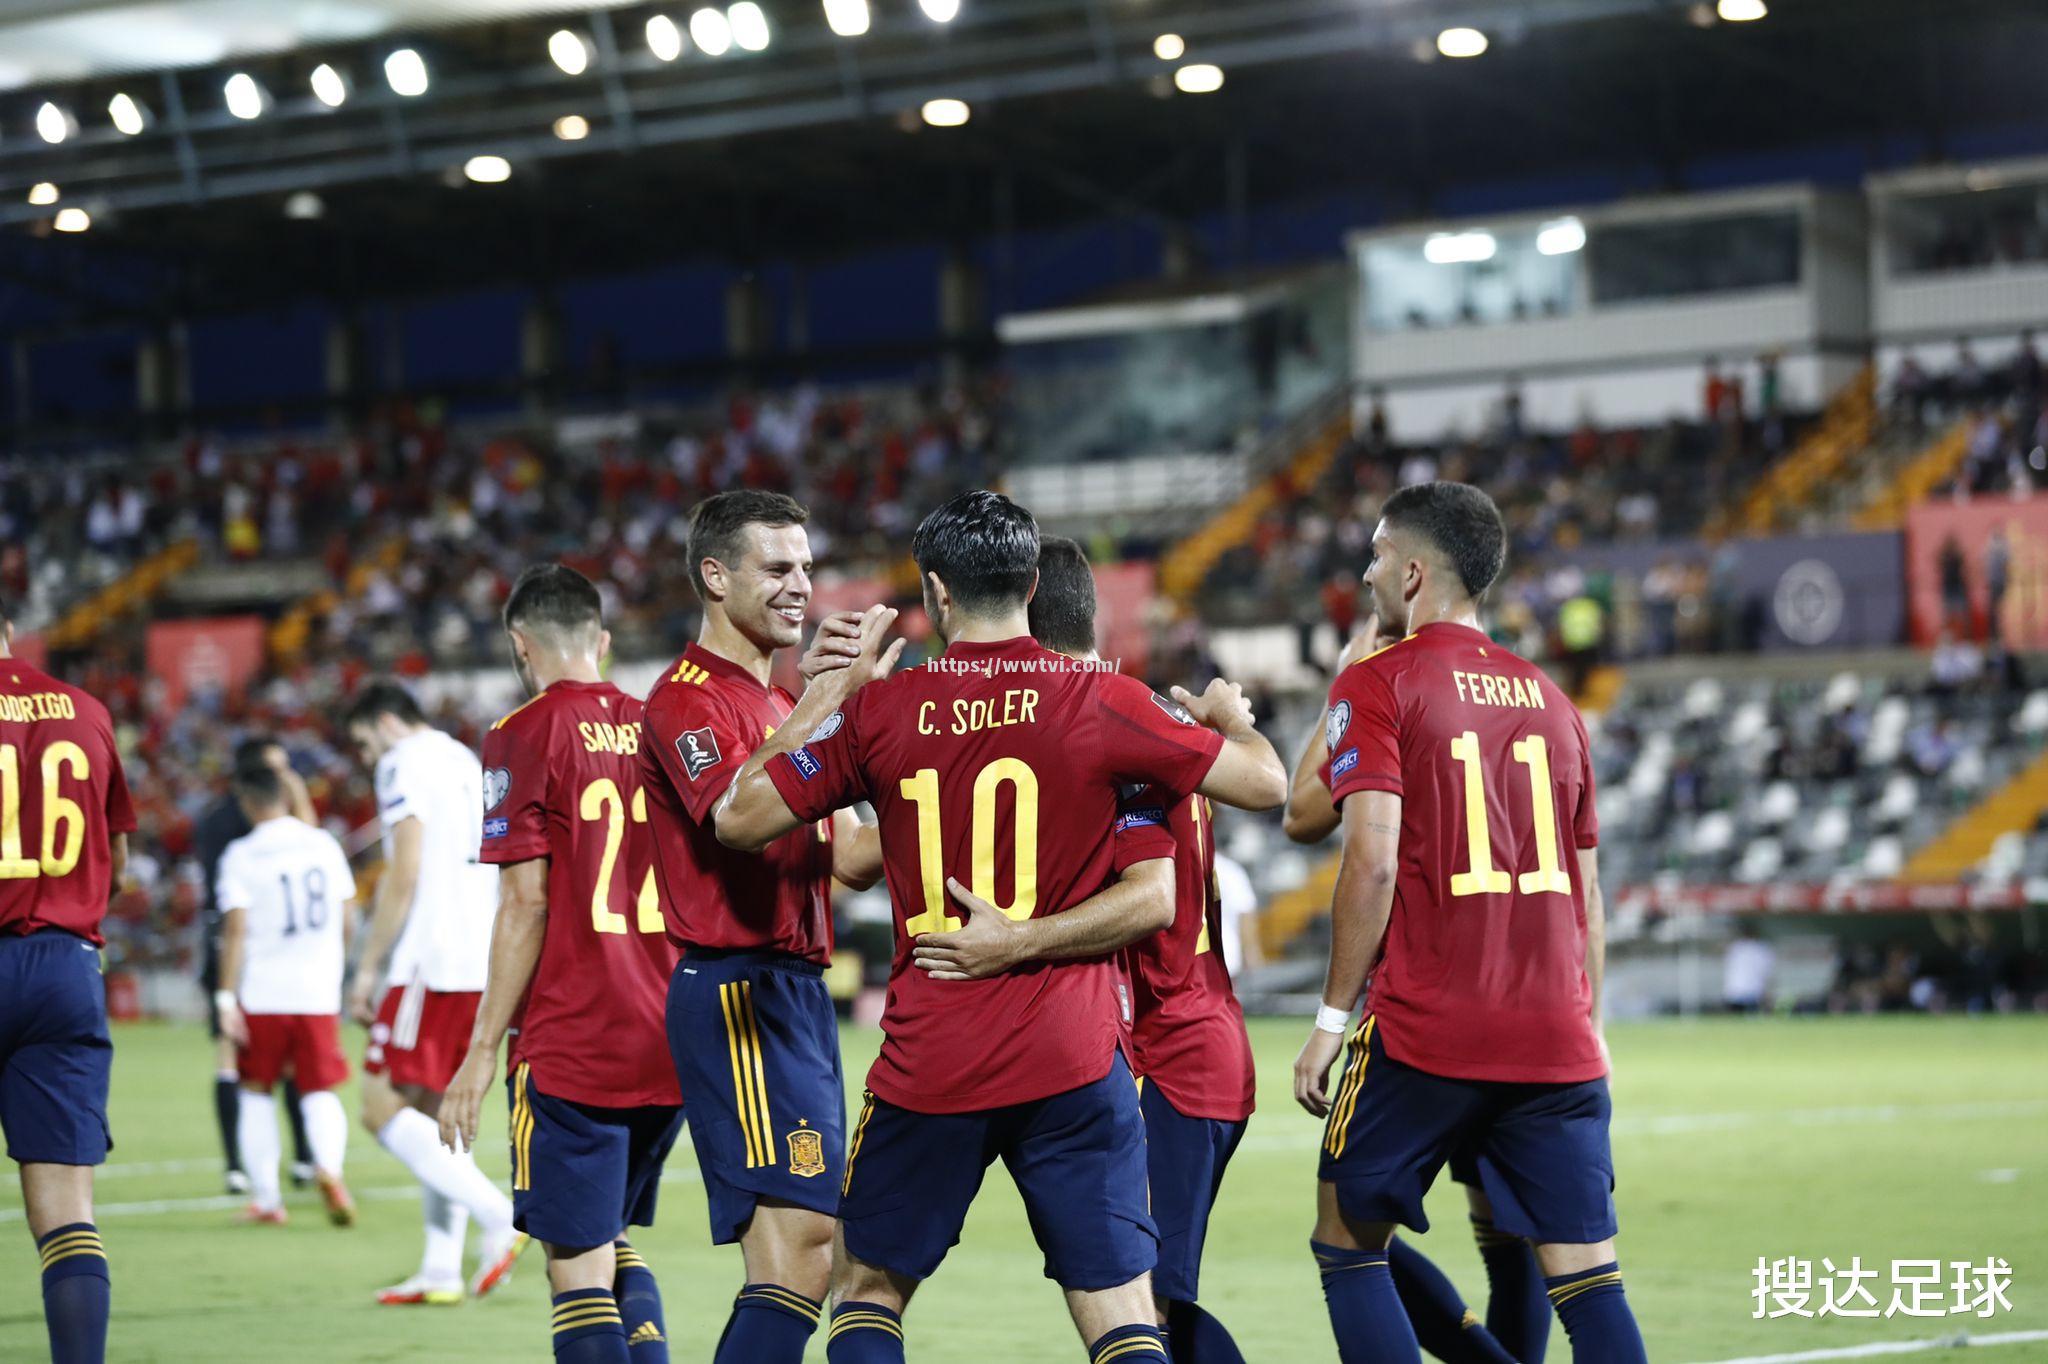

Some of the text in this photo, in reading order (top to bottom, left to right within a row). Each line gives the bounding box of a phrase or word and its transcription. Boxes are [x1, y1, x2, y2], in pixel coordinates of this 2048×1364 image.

[0, 692, 76, 723] ODRIGO
[917, 688, 1039, 736] C. SOLER
[1453, 671, 1546, 710] FERRAN
[793, 748, 817, 775] ESPECT
[0, 740, 90, 880] 16
[1125, 809, 1163, 822] RESPECT
[1451, 731, 1572, 897] 11
[900, 757, 1039, 938] 10
[279, 867, 329, 937] 18
